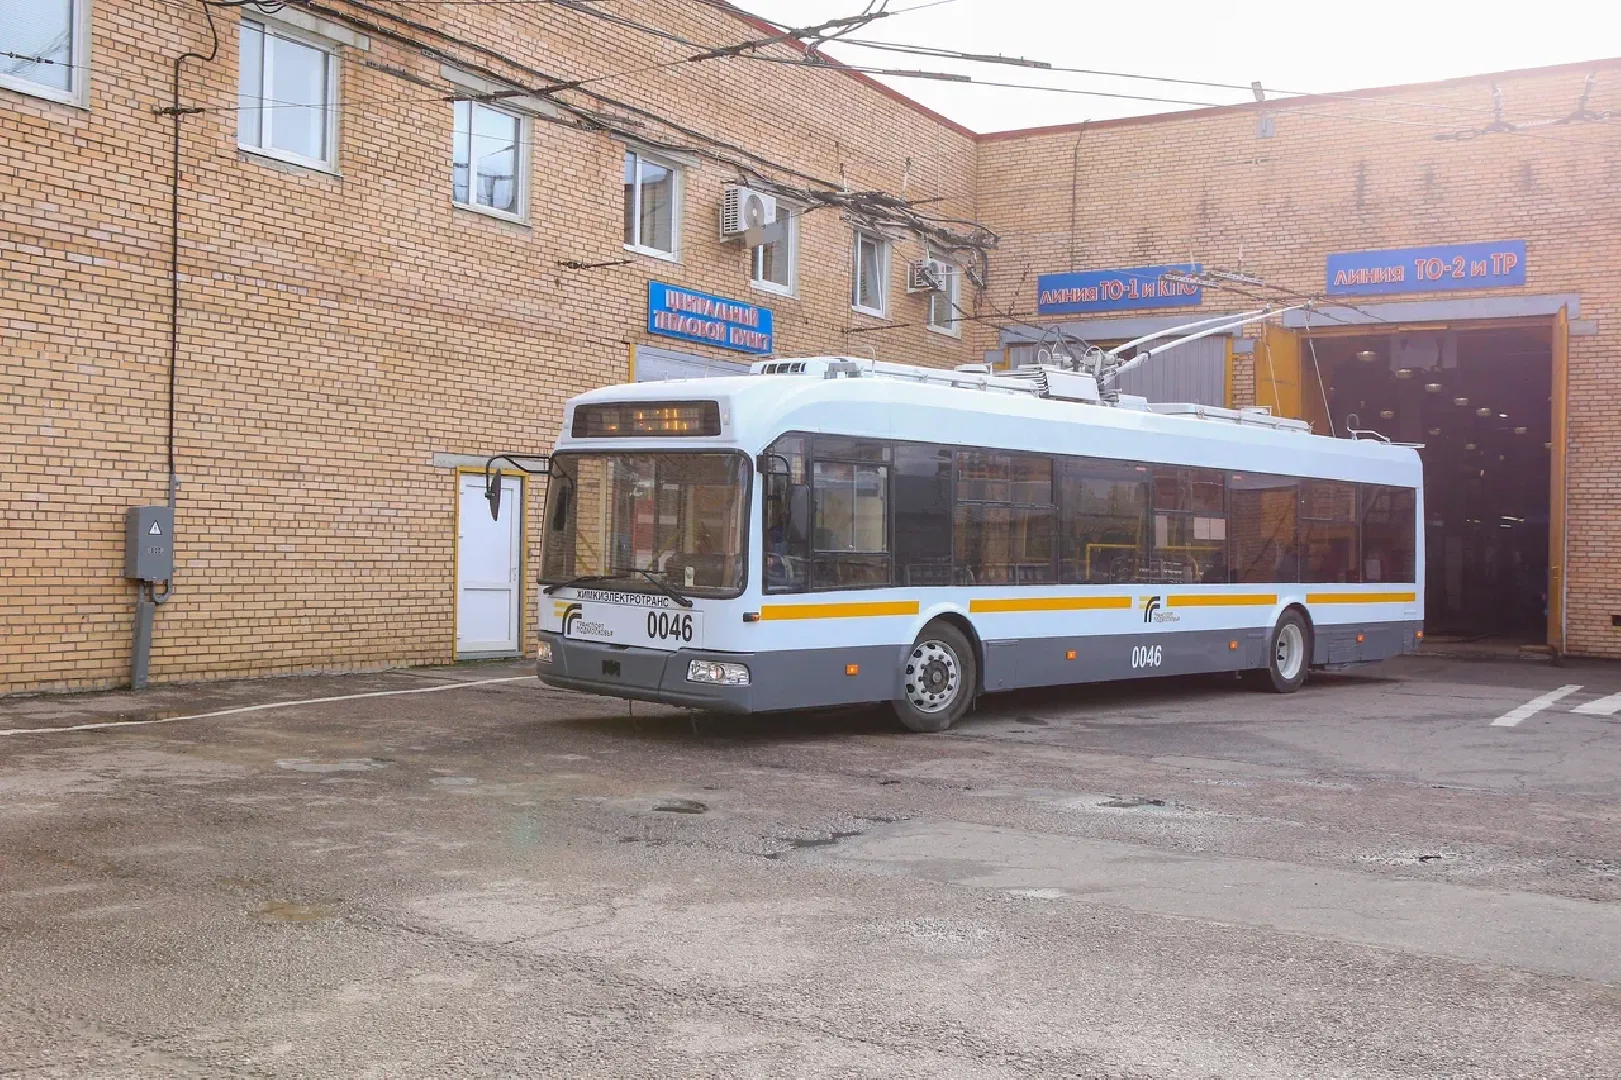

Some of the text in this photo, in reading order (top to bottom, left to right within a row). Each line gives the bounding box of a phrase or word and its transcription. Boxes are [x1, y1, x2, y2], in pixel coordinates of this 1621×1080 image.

[1414, 256, 1466, 280] ТО-2
[1490, 252, 1518, 275] ТР
[1100, 278, 1139, 301] ТО-1
[665, 288, 760, 328] ЦЕНТРАЛЬНЫЙ
[653, 309, 771, 351] ТЕПЛОВОЙ ПУНКТ
[647, 610, 693, 642] 0046
[1131, 644, 1162, 669] 0046
